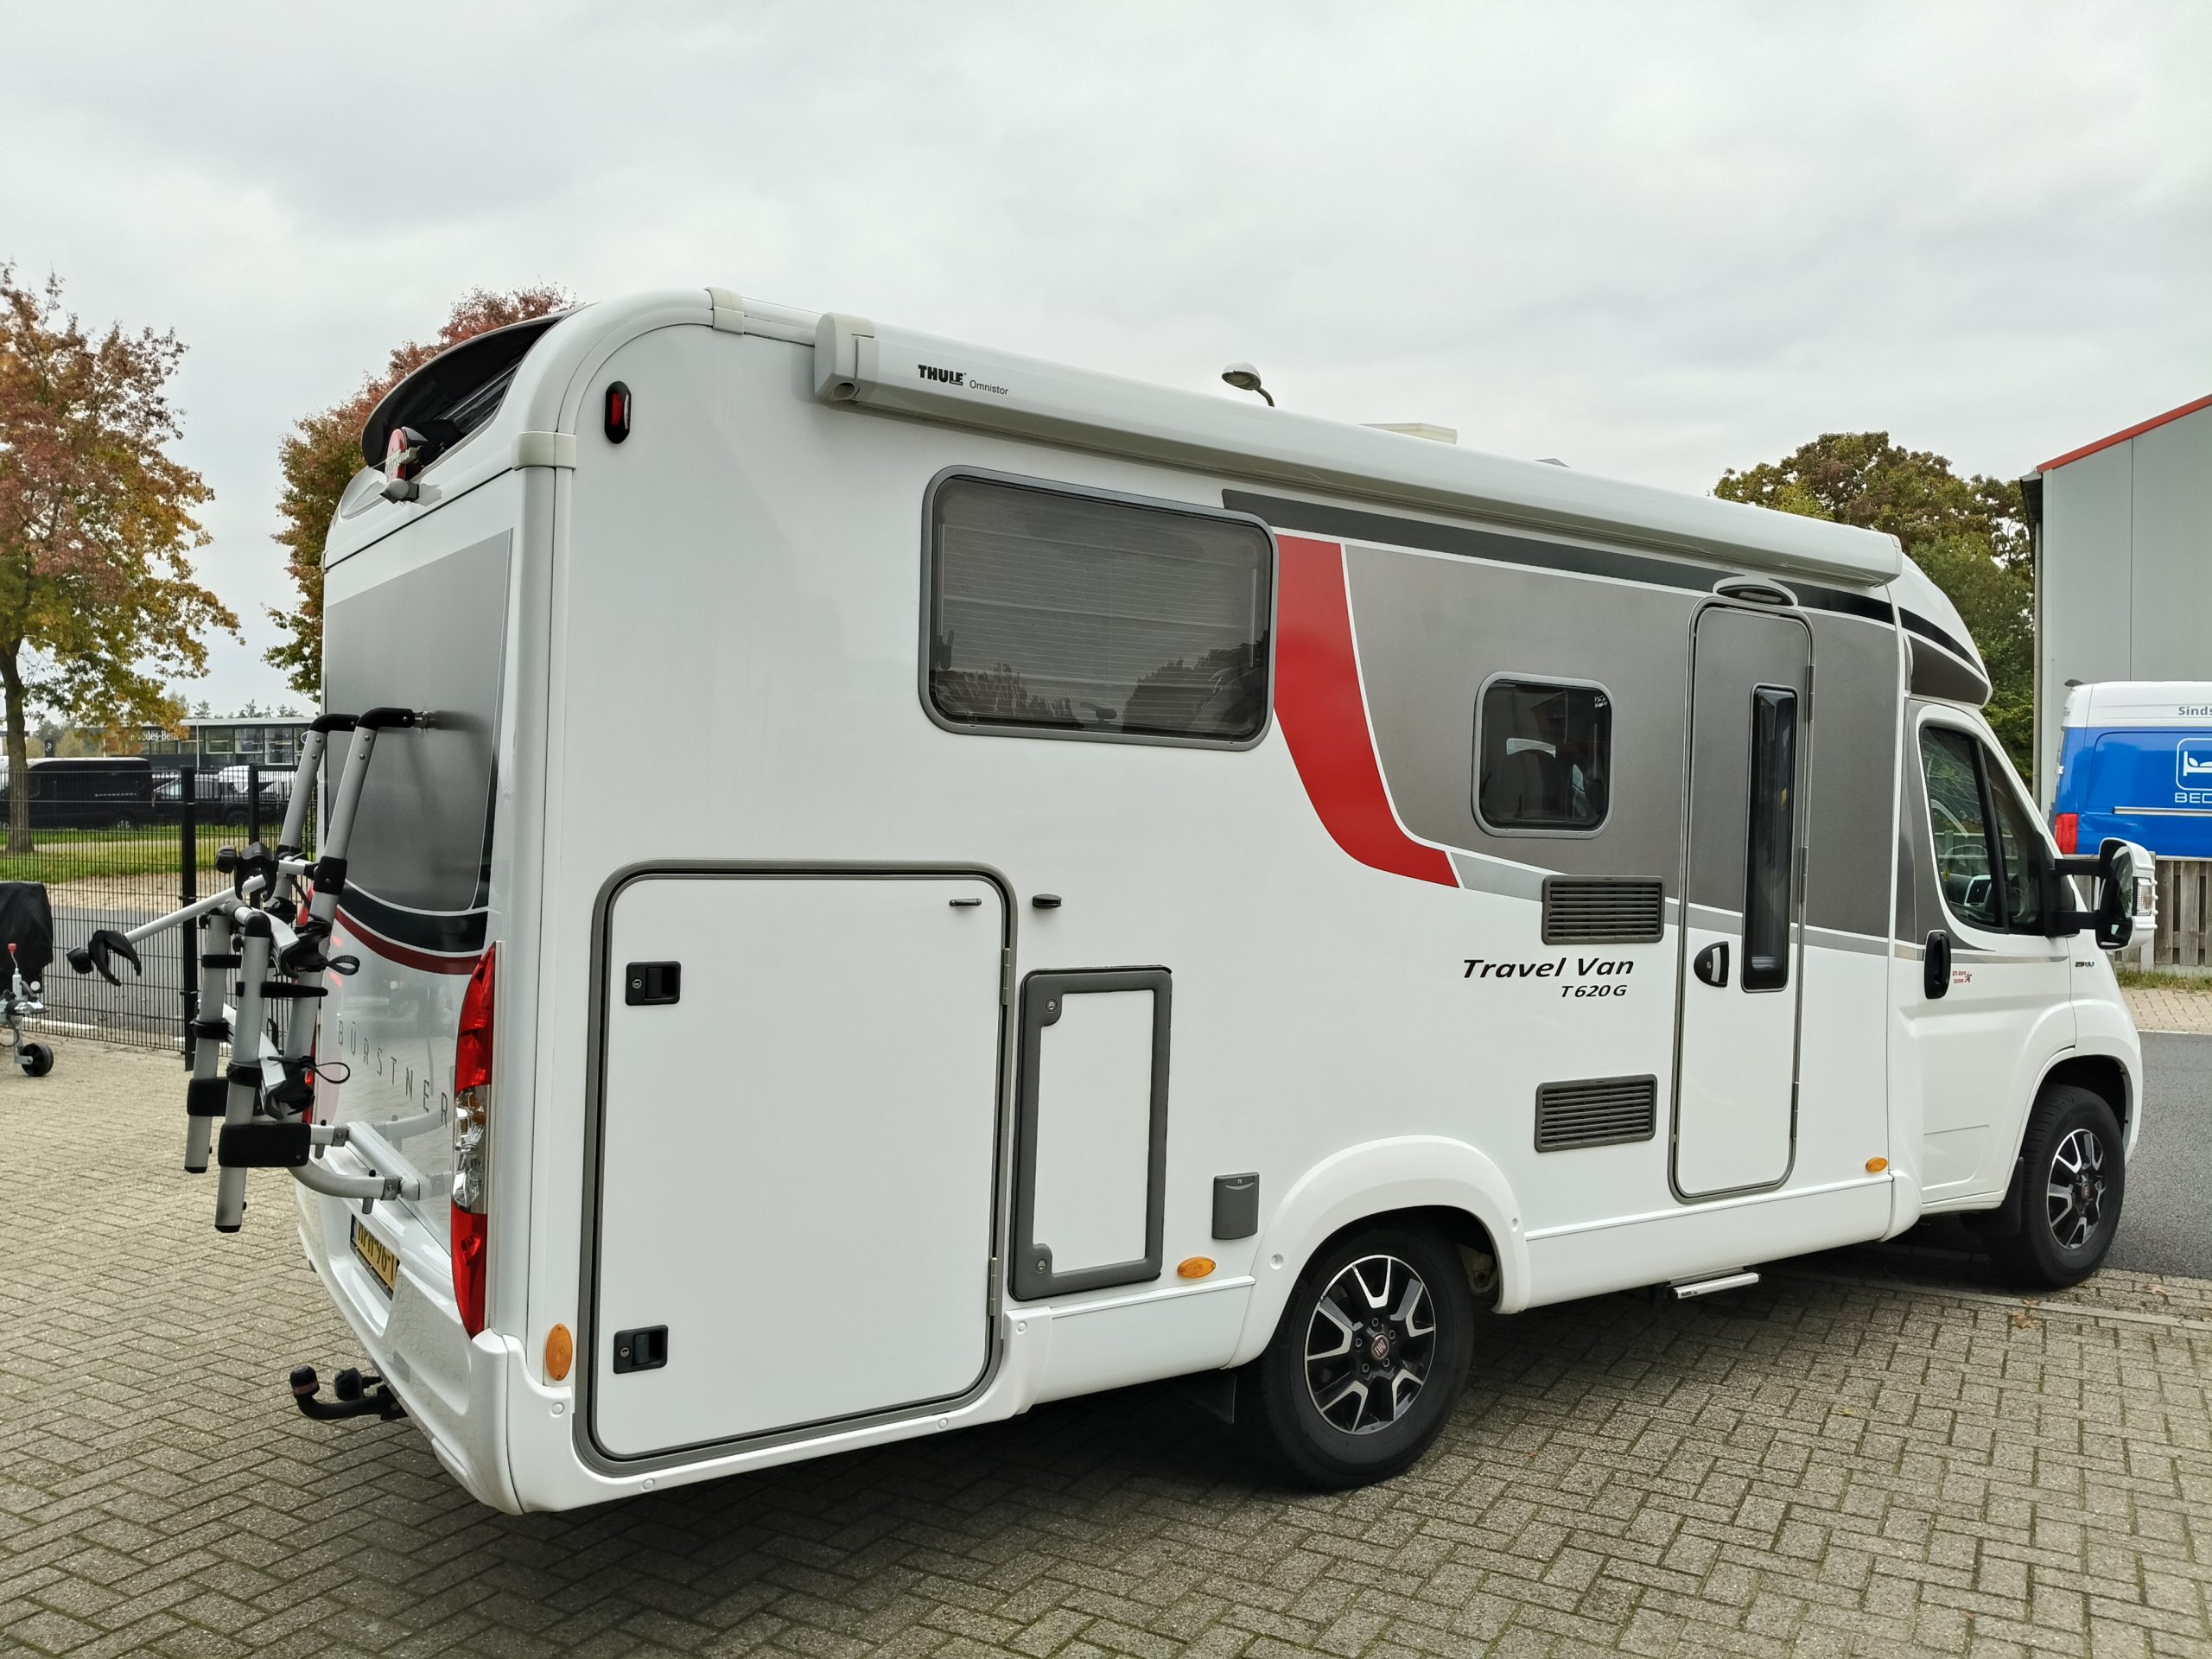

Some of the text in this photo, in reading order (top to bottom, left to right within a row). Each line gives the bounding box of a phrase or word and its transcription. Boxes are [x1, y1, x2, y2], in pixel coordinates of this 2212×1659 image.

[918, 364, 1009, 395] THULE Omnistor
[1462, 957, 1635, 979] Travel Van
[338, 1020, 448, 1128] BÜRSTNER
[1374, 1339, 1387, 1356] FIAT
